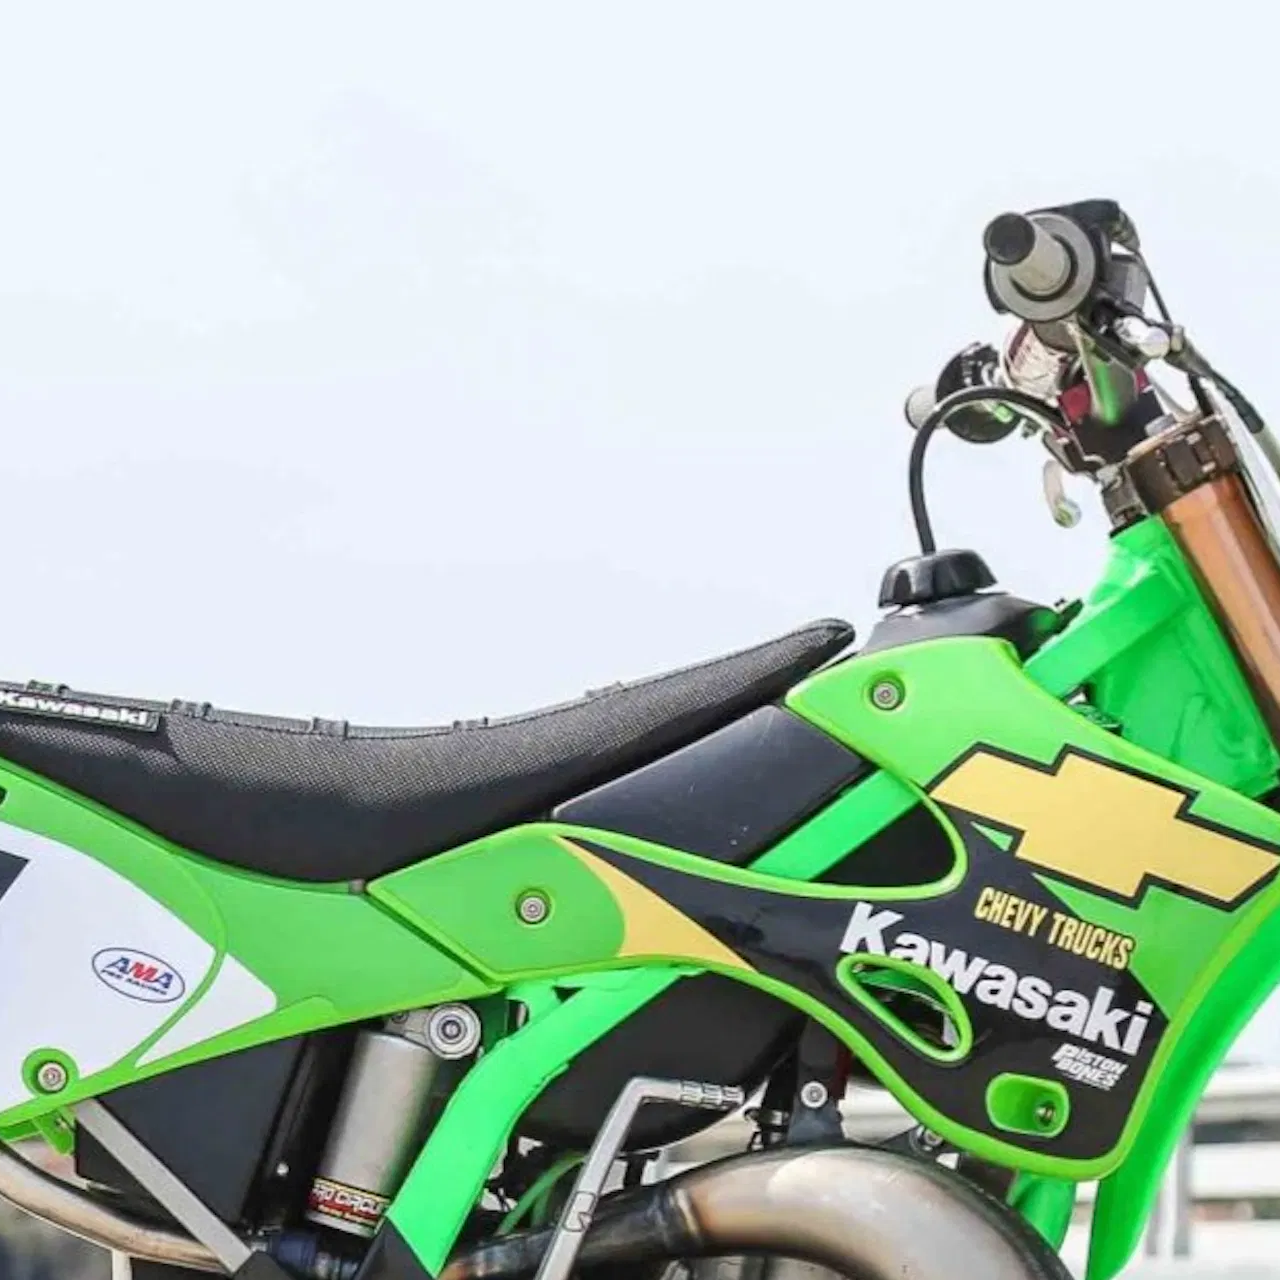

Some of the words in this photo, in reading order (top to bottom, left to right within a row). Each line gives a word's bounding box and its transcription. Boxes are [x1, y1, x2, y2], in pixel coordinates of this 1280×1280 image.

[974, 886, 1048, 938] CHEVY
[1048, 911, 1136, 971] TRUCKS
[105, 956, 174, 989] AMA
[839, 901, 1154, 1056] Kawasaki
[1051, 1043, 1128, 1075] PISTON
